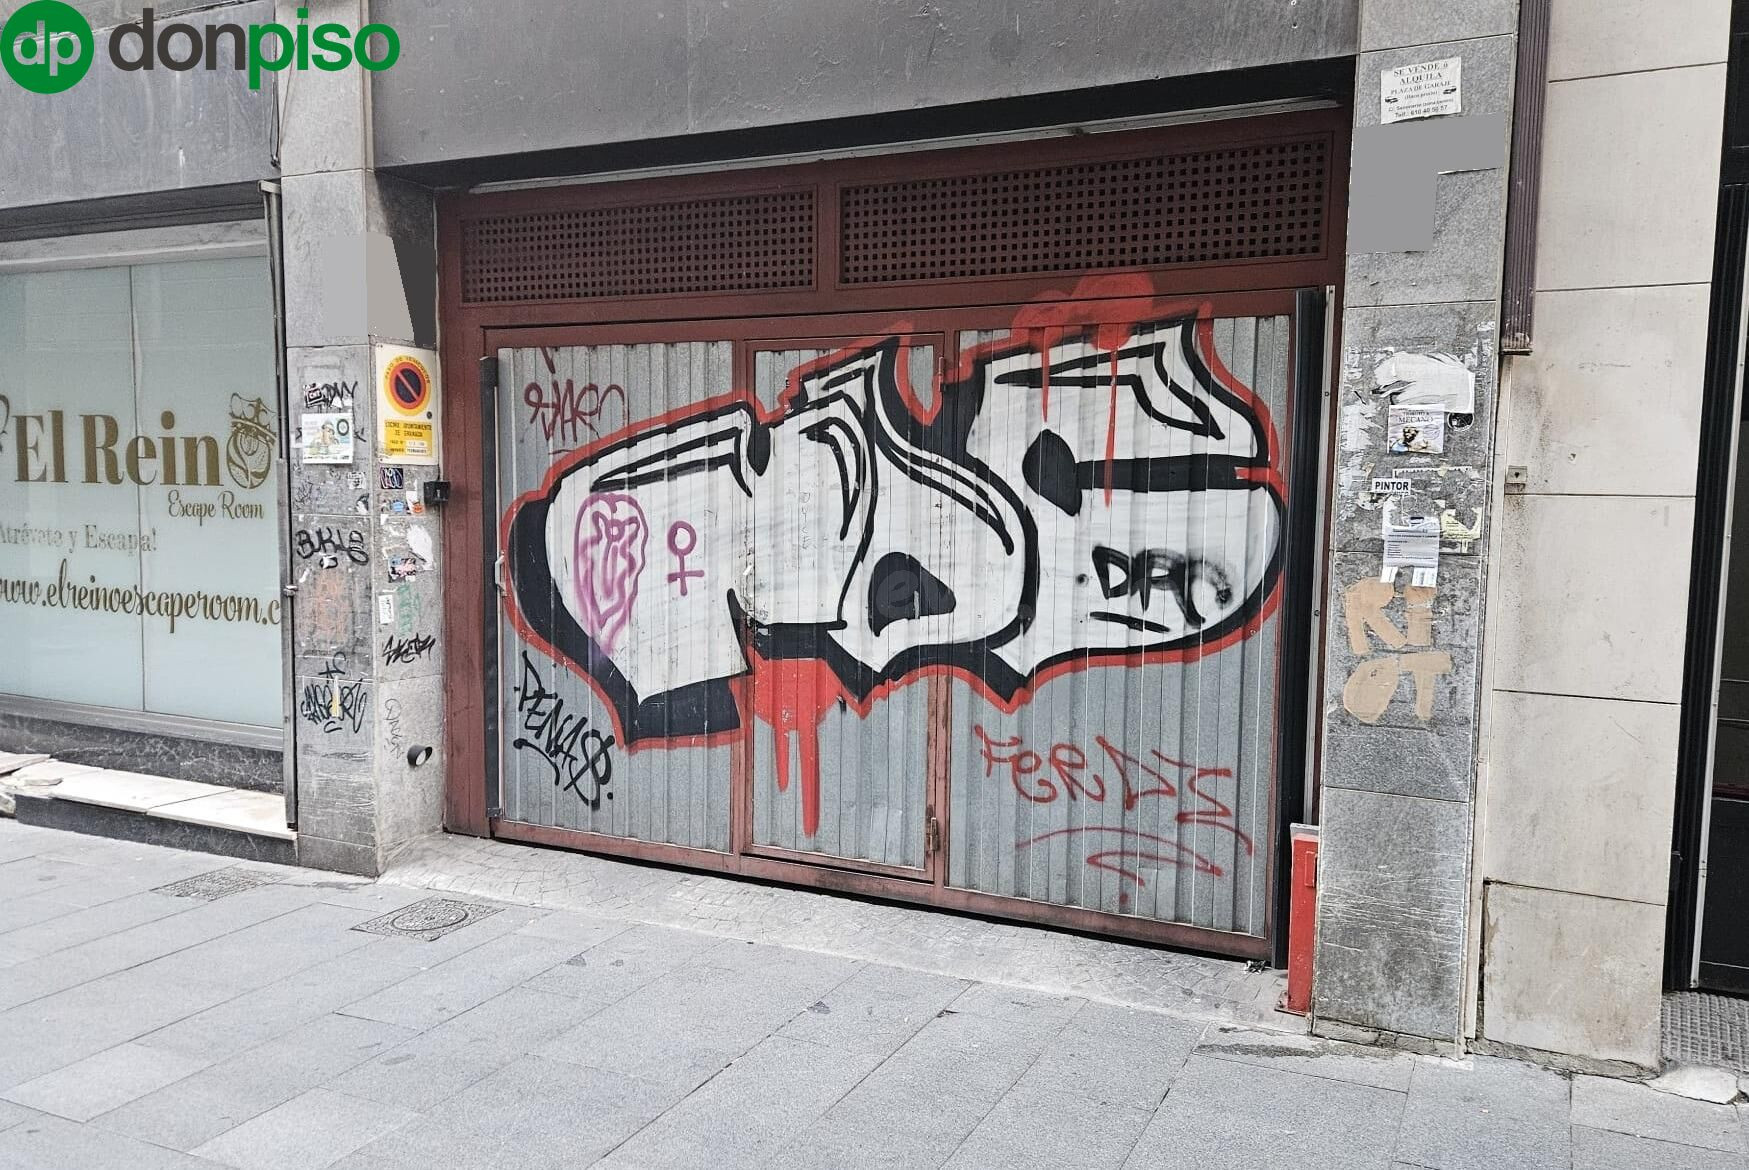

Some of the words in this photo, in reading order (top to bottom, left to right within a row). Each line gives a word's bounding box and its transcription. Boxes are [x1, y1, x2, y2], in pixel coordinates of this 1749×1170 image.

[1400, 72, 1443, 86] ALQUILA
[1408, 63, 1440, 75] VENDE
[12, 410, 69, 484] El
[1375, 481, 1409, 491] PINTOR
[168, 489, 216, 527] Escape
[218, 491, 265, 520] Room
[0, 558, 281, 634] ww.elreinoescaperoom.c
